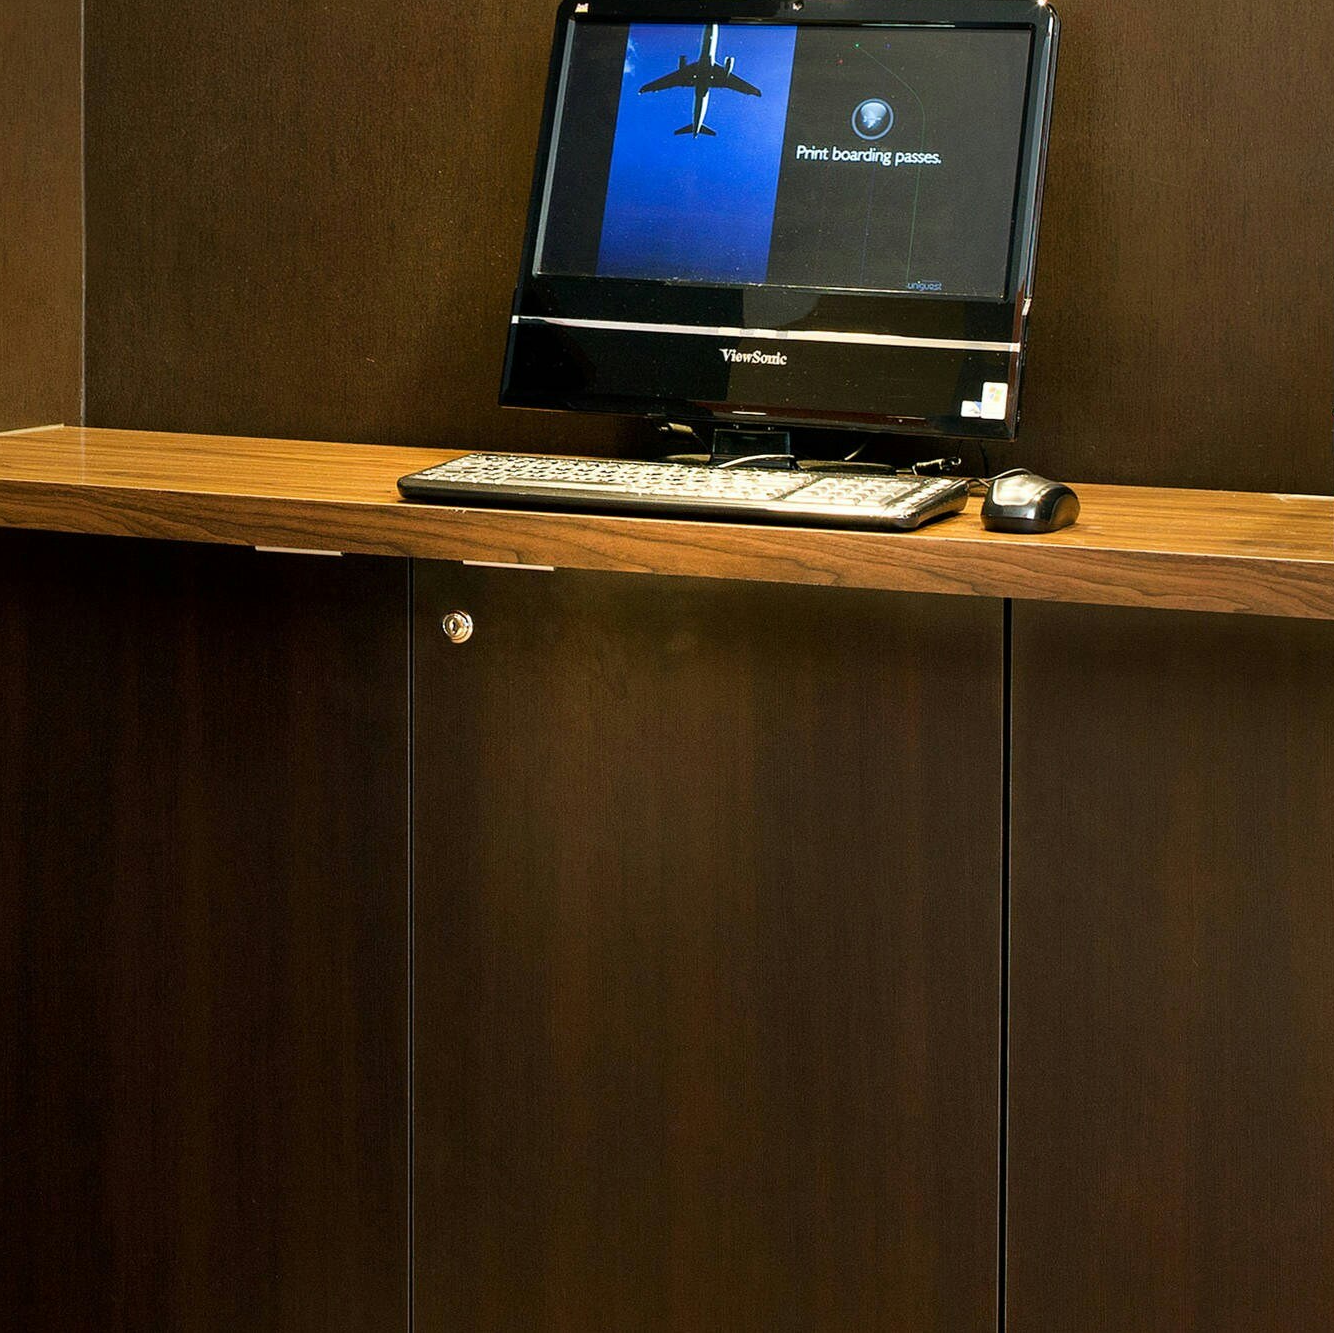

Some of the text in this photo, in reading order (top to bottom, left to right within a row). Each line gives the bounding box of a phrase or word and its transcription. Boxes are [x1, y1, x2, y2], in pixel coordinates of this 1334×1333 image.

[795, 144, 942, 167] Print boarding passes.
[718, 347, 788, 366] ViewSonic
